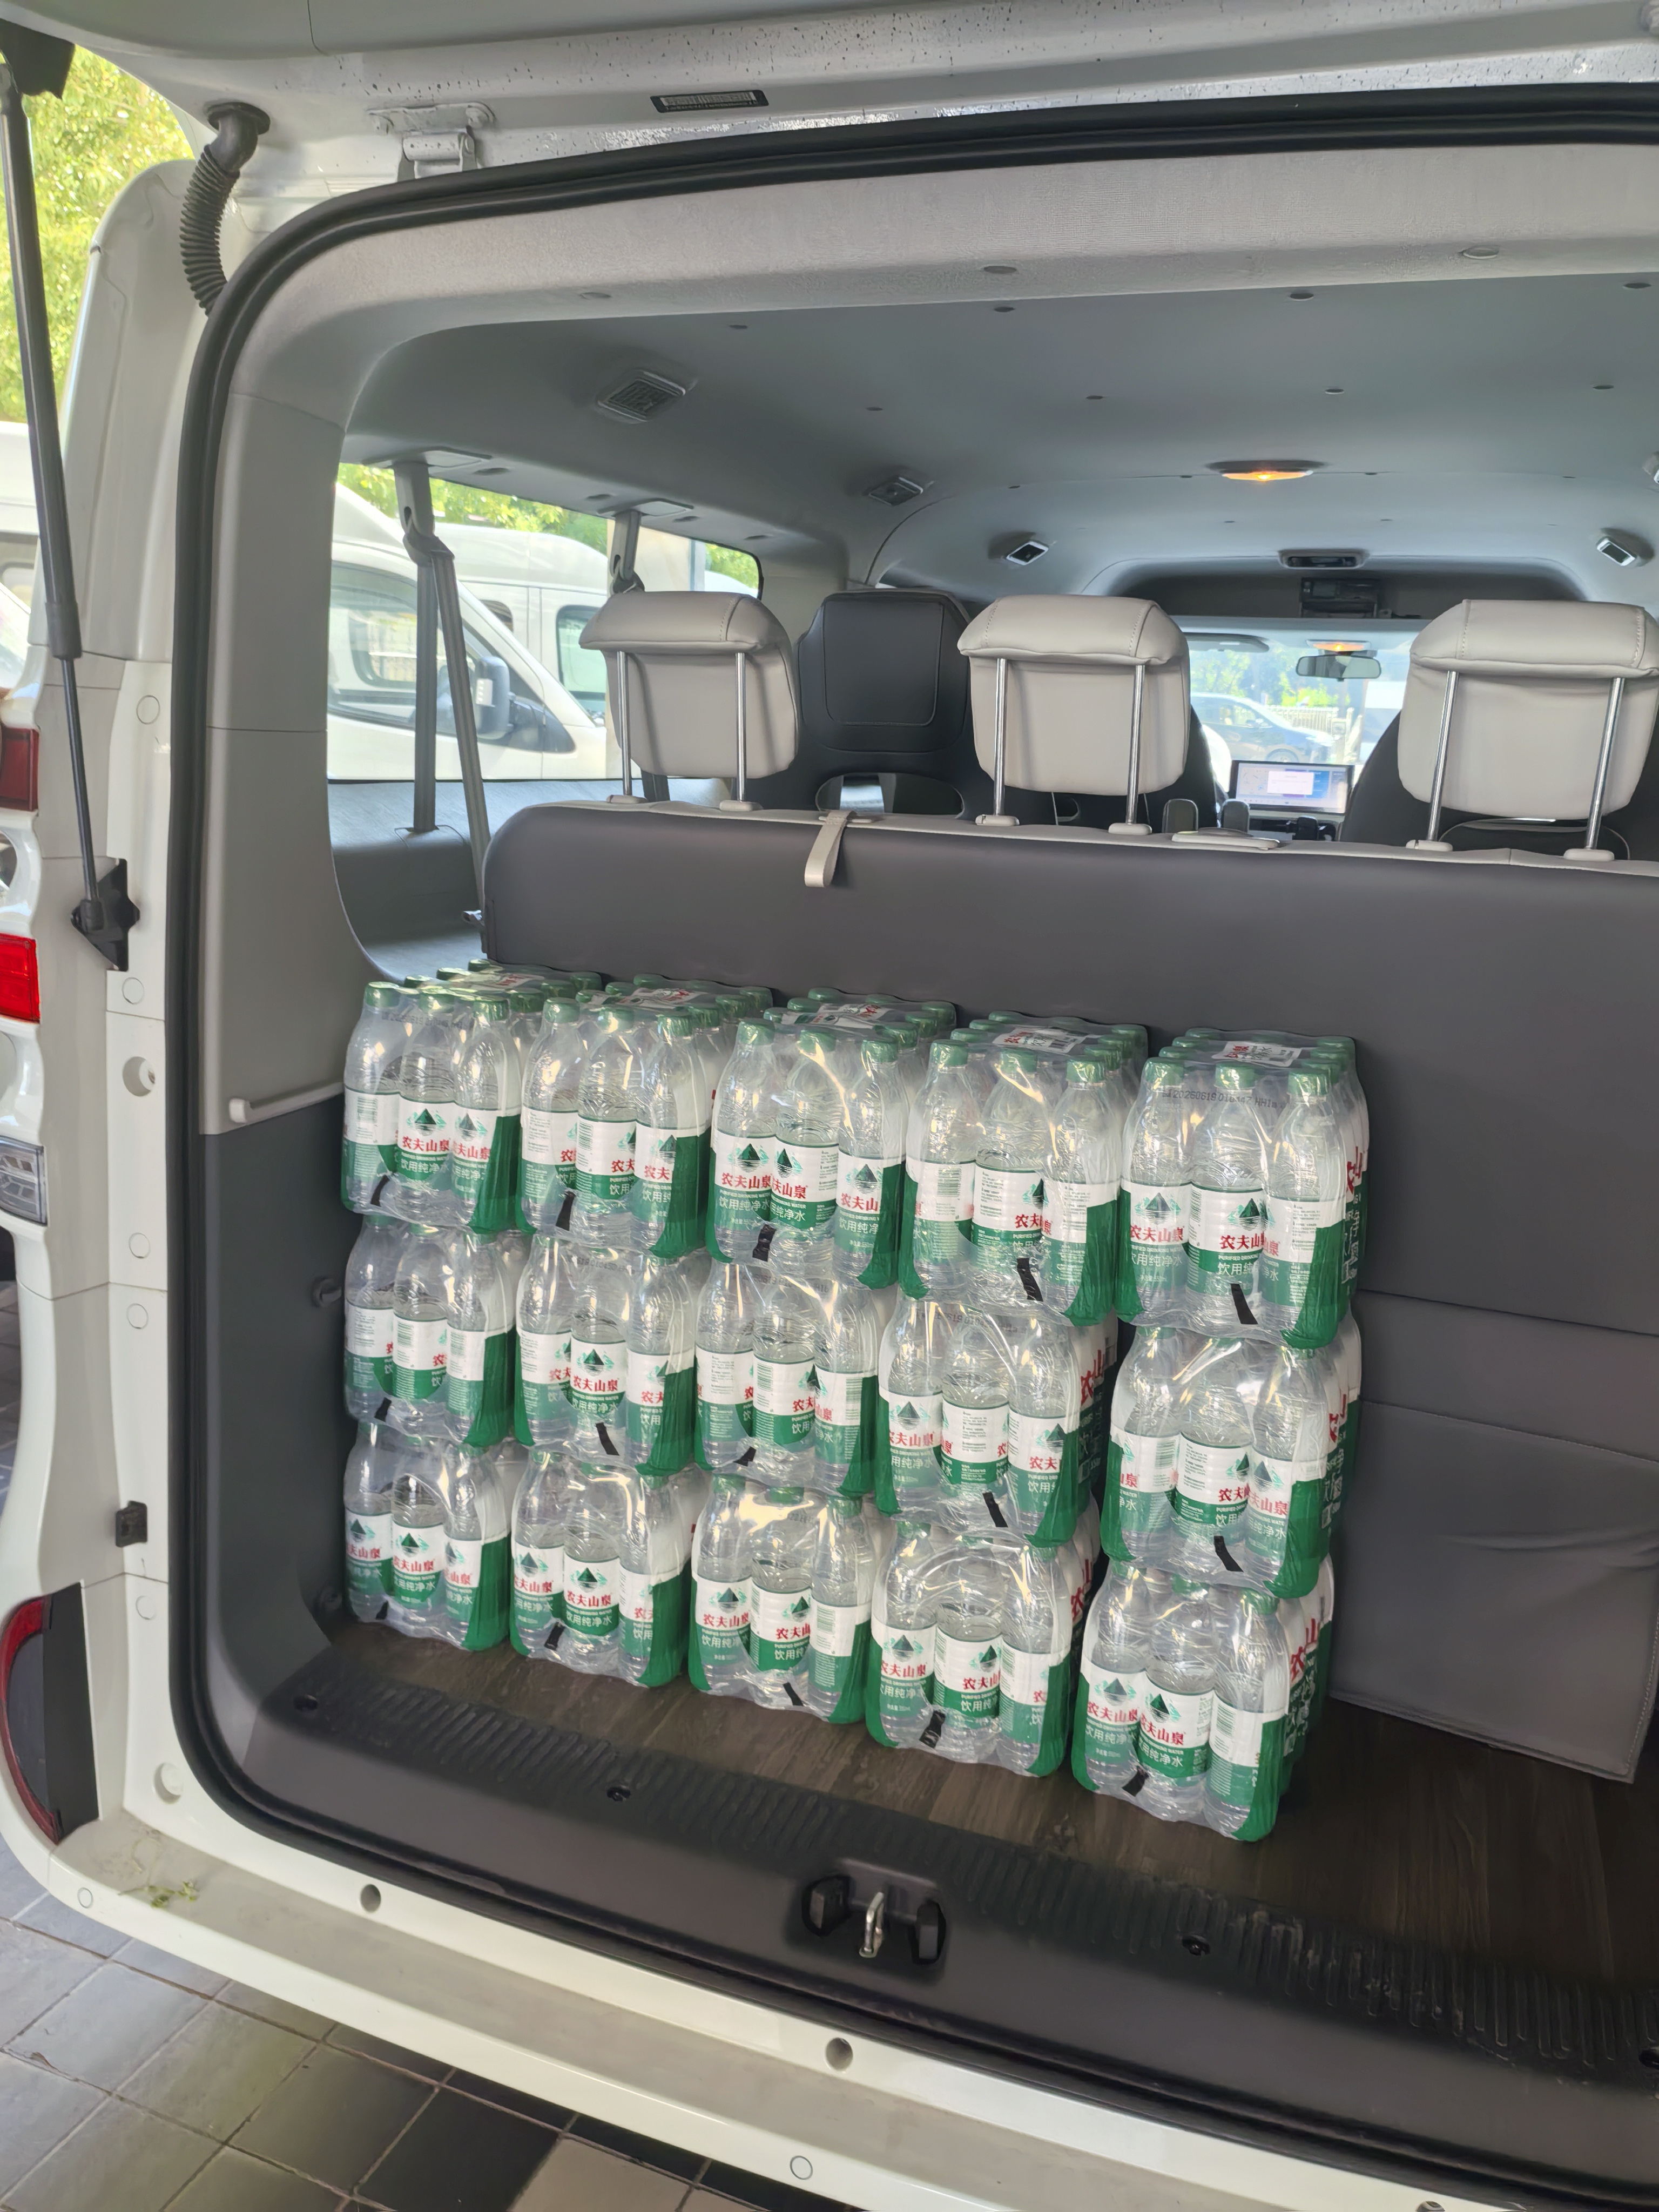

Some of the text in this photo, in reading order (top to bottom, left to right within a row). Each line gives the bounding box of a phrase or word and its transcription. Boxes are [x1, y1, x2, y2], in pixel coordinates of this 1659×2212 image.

[561, 1148, 576, 1162] 农
[721, 1173, 772, 1189] 农夫山泉
